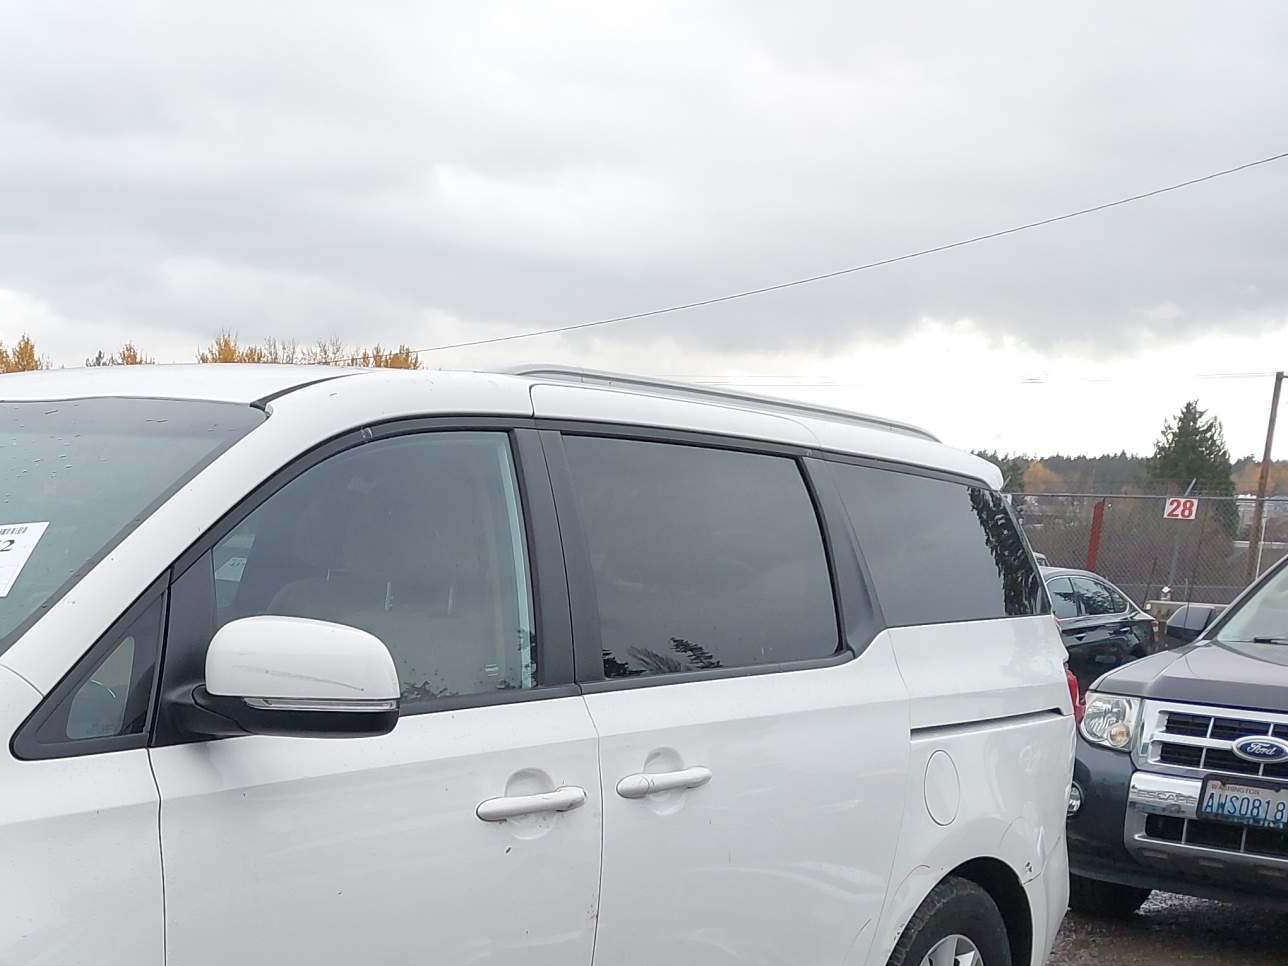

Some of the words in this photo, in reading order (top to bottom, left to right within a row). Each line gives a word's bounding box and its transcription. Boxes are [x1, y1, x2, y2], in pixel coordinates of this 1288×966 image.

[1167, 500, 1194, 518] 28
[1246, 743, 1277, 755] Ford
[1211, 783, 1262, 796] WASHINGTON
[1204, 793, 1286, 822] AWS0818
